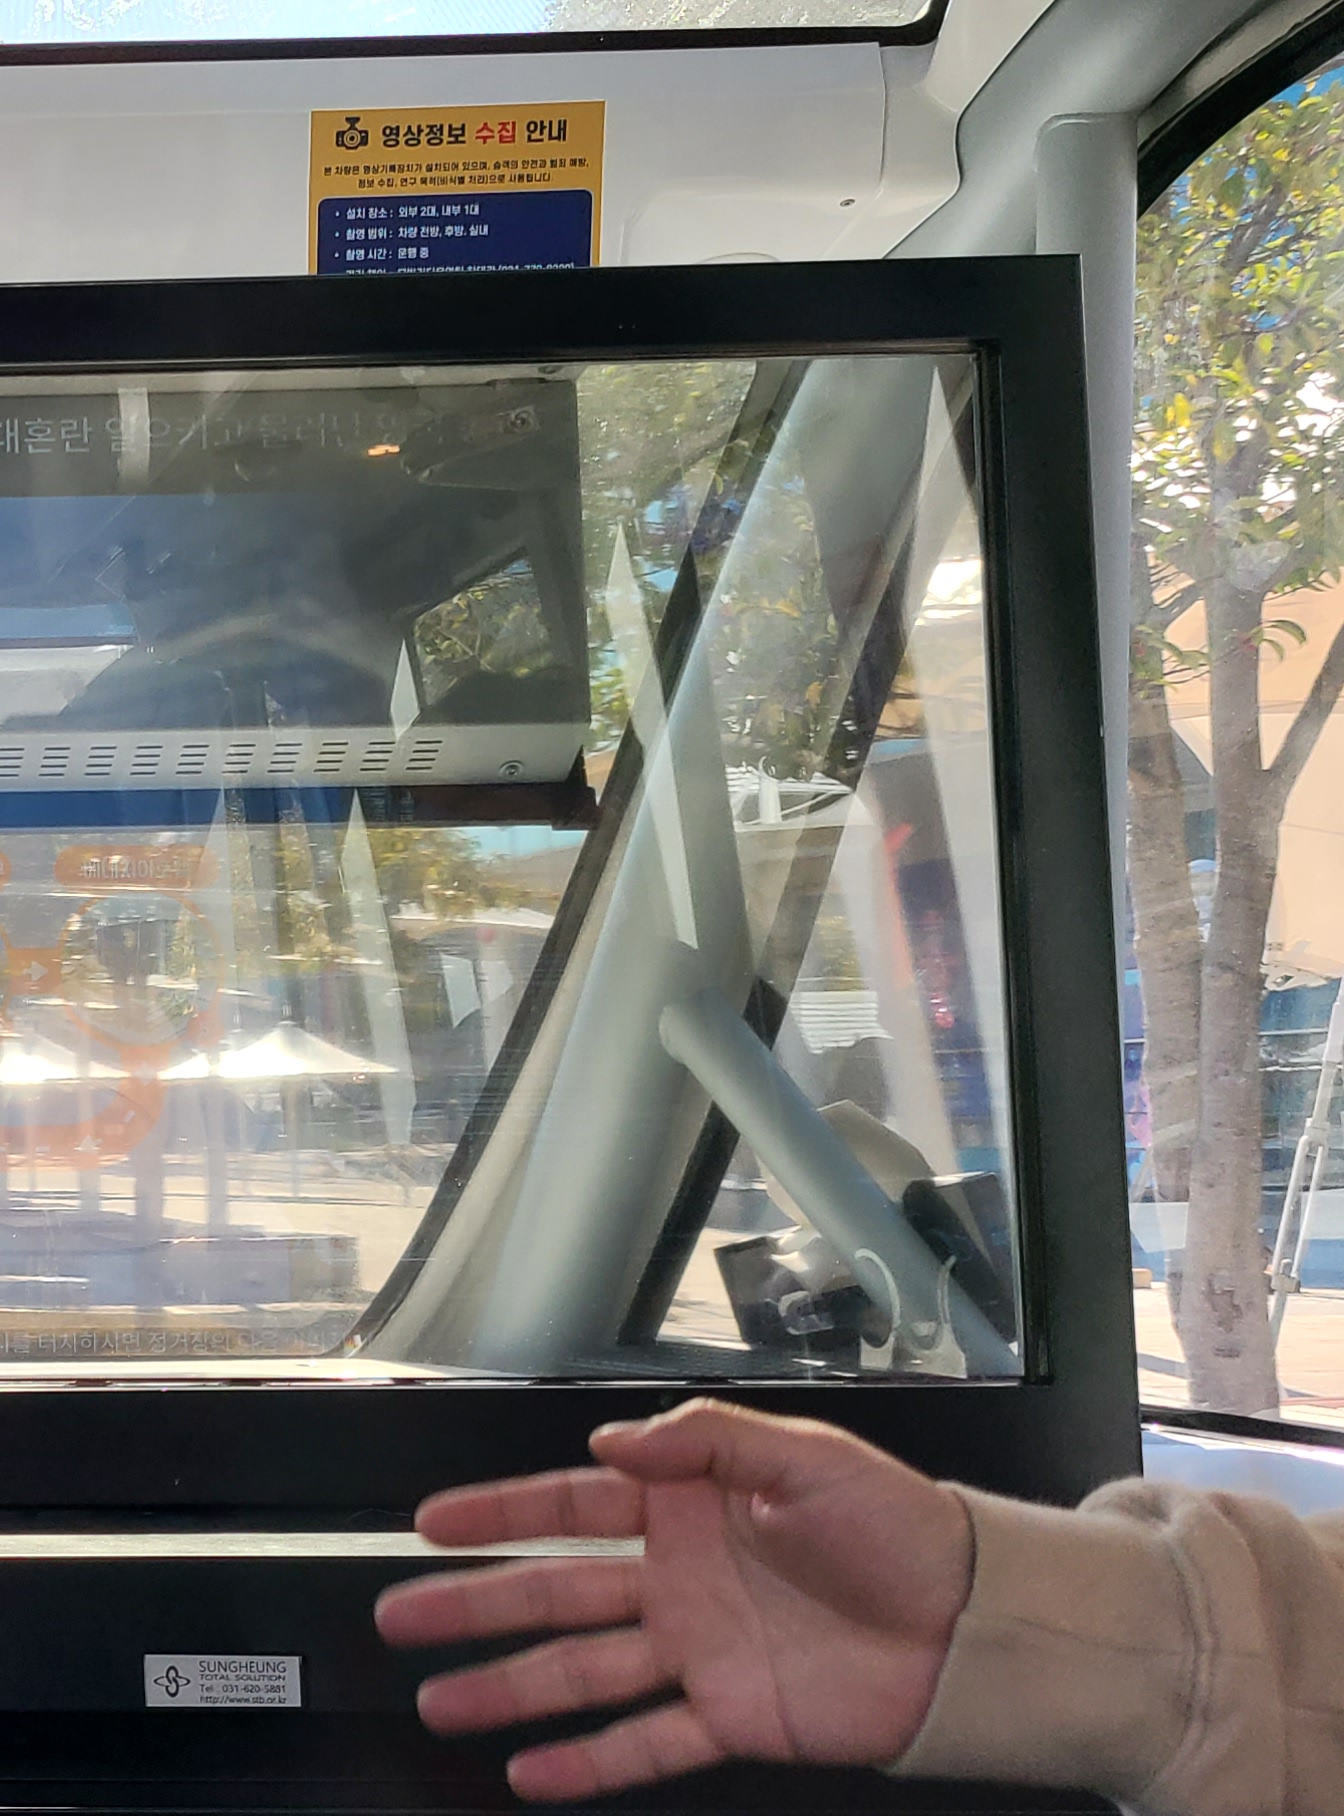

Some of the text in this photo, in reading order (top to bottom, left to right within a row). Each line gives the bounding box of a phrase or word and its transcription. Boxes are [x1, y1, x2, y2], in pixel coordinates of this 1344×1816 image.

[381, 118, 567, 148] 영상정보 수집 안내
[346, 207, 366, 220] 설치
[398, 205, 418, 218] 외부
[441, 204, 461, 217] 내부
[464, 203, 480, 216] 1대
[398, 226, 418, 239] 차량
[469, 224, 489, 237] 실내
[419, 247, 429, 258] 중
[38, 1331, 142, 1353] 터치하시면
[198, 1660, 287, 1674] SUNGHEUNG
[199, 1673, 286, 1681] TOTAL SOLUTION
